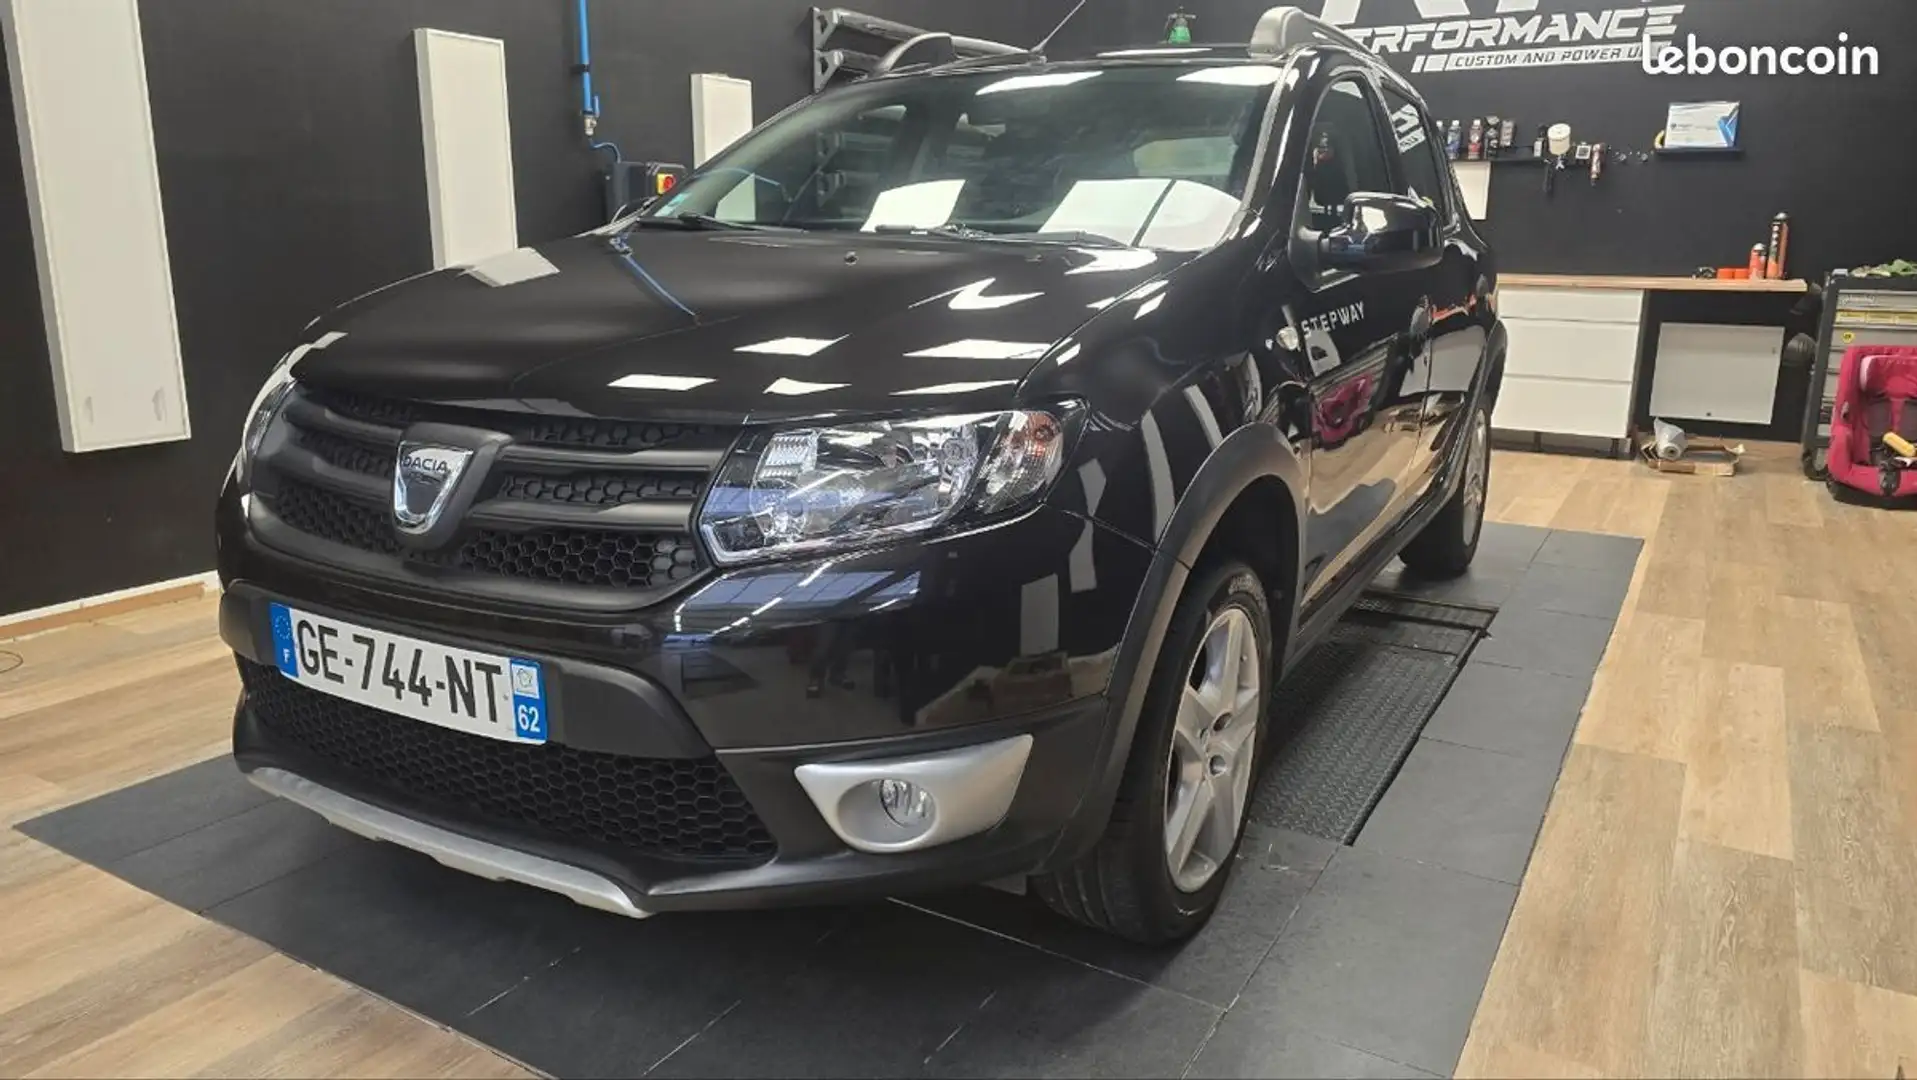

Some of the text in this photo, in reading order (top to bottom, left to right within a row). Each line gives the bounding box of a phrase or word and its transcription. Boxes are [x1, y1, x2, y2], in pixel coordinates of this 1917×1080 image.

[1343, 5, 1686, 53] ERFORMANCE
[1455, 54, 1517, 67] CUSTOM
[1522, 51, 1555, 64] AND
[1560, 47, 1621, 62] POWER
[1301, 301, 1364, 339] STEPWAY
[401, 456, 448, 473] DACIA
[297, 619, 502, 723] GE-744-NT
[518, 704, 541, 732] 62
